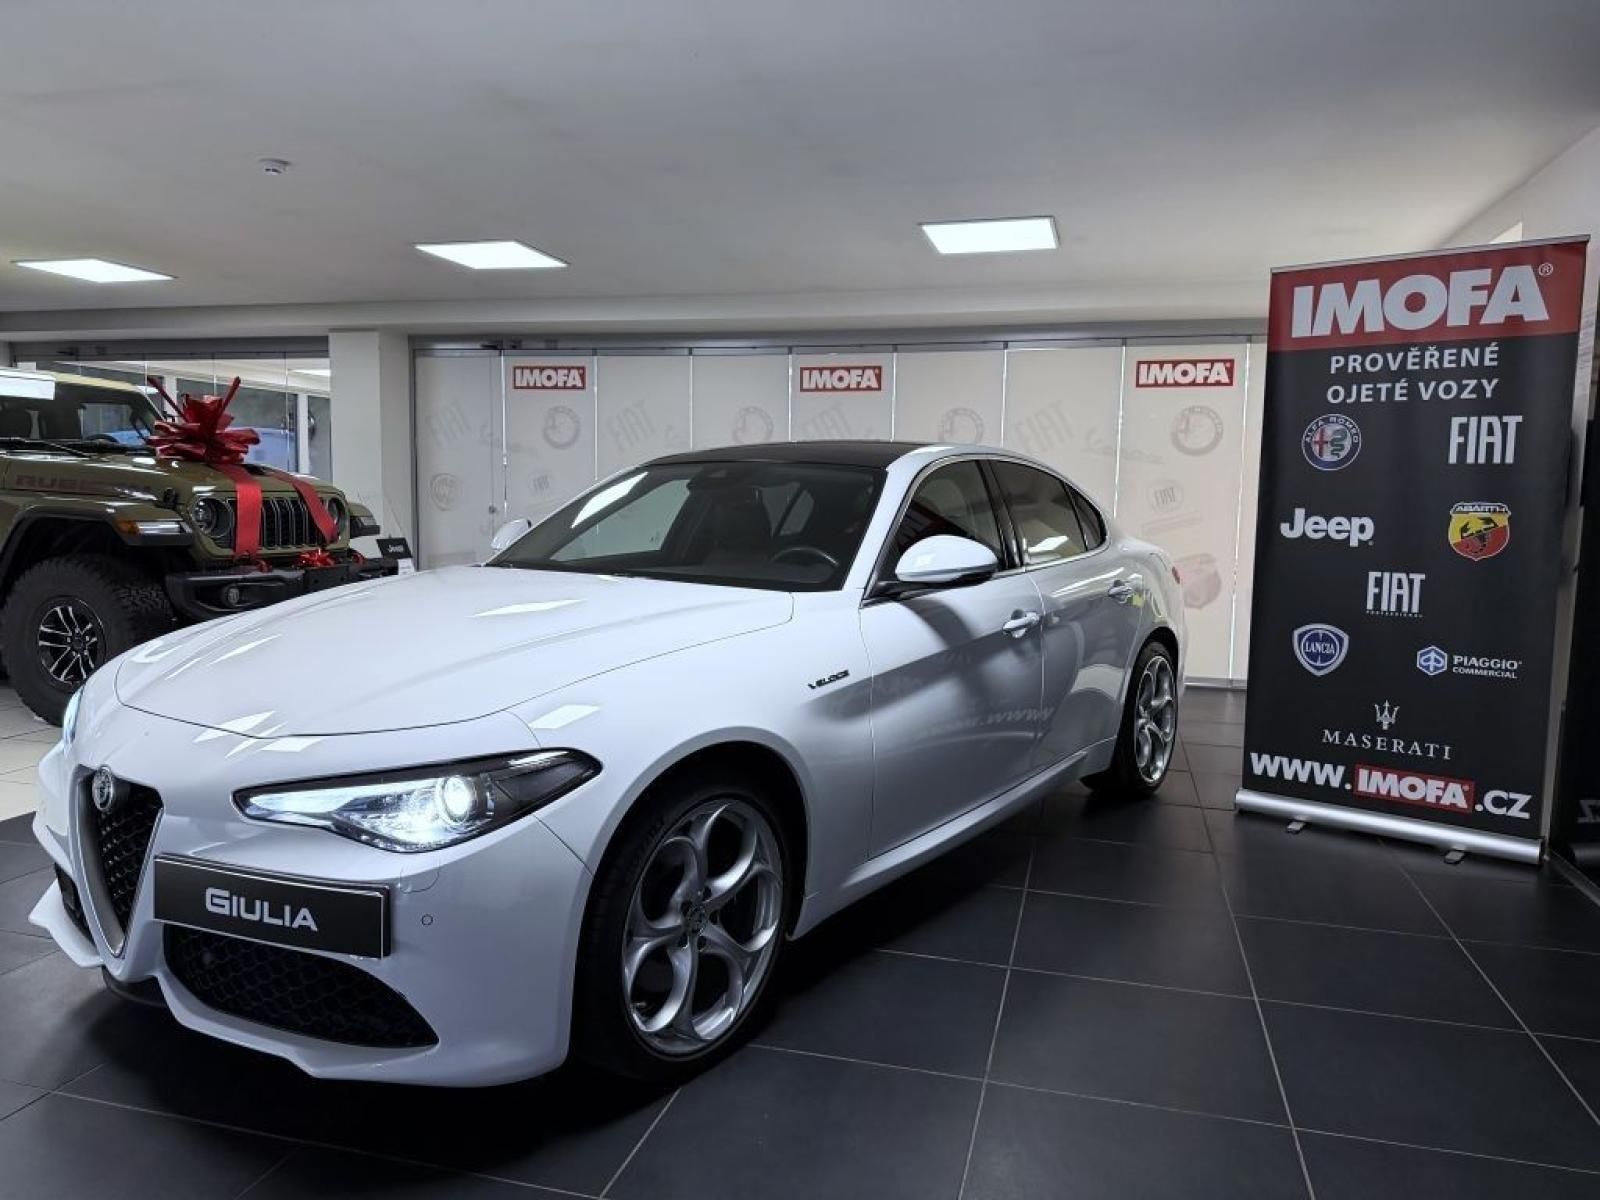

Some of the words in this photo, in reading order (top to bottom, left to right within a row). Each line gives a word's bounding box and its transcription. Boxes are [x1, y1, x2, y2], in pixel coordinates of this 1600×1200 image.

[1330, 341, 1499, 374] PROVĚŘENÉ
[1327, 378, 1408, 404] OJETÉ
[1418, 378, 1499, 401] VOZY
[1448, 415, 1523, 464] FIAT
[1280, 507, 1374, 547] Jeep
[1366, 571, 1426, 613] FIAT
[1452, 666, 1518, 679] COMMERCIAL
[1322, 728, 1452, 760] MASERATI
